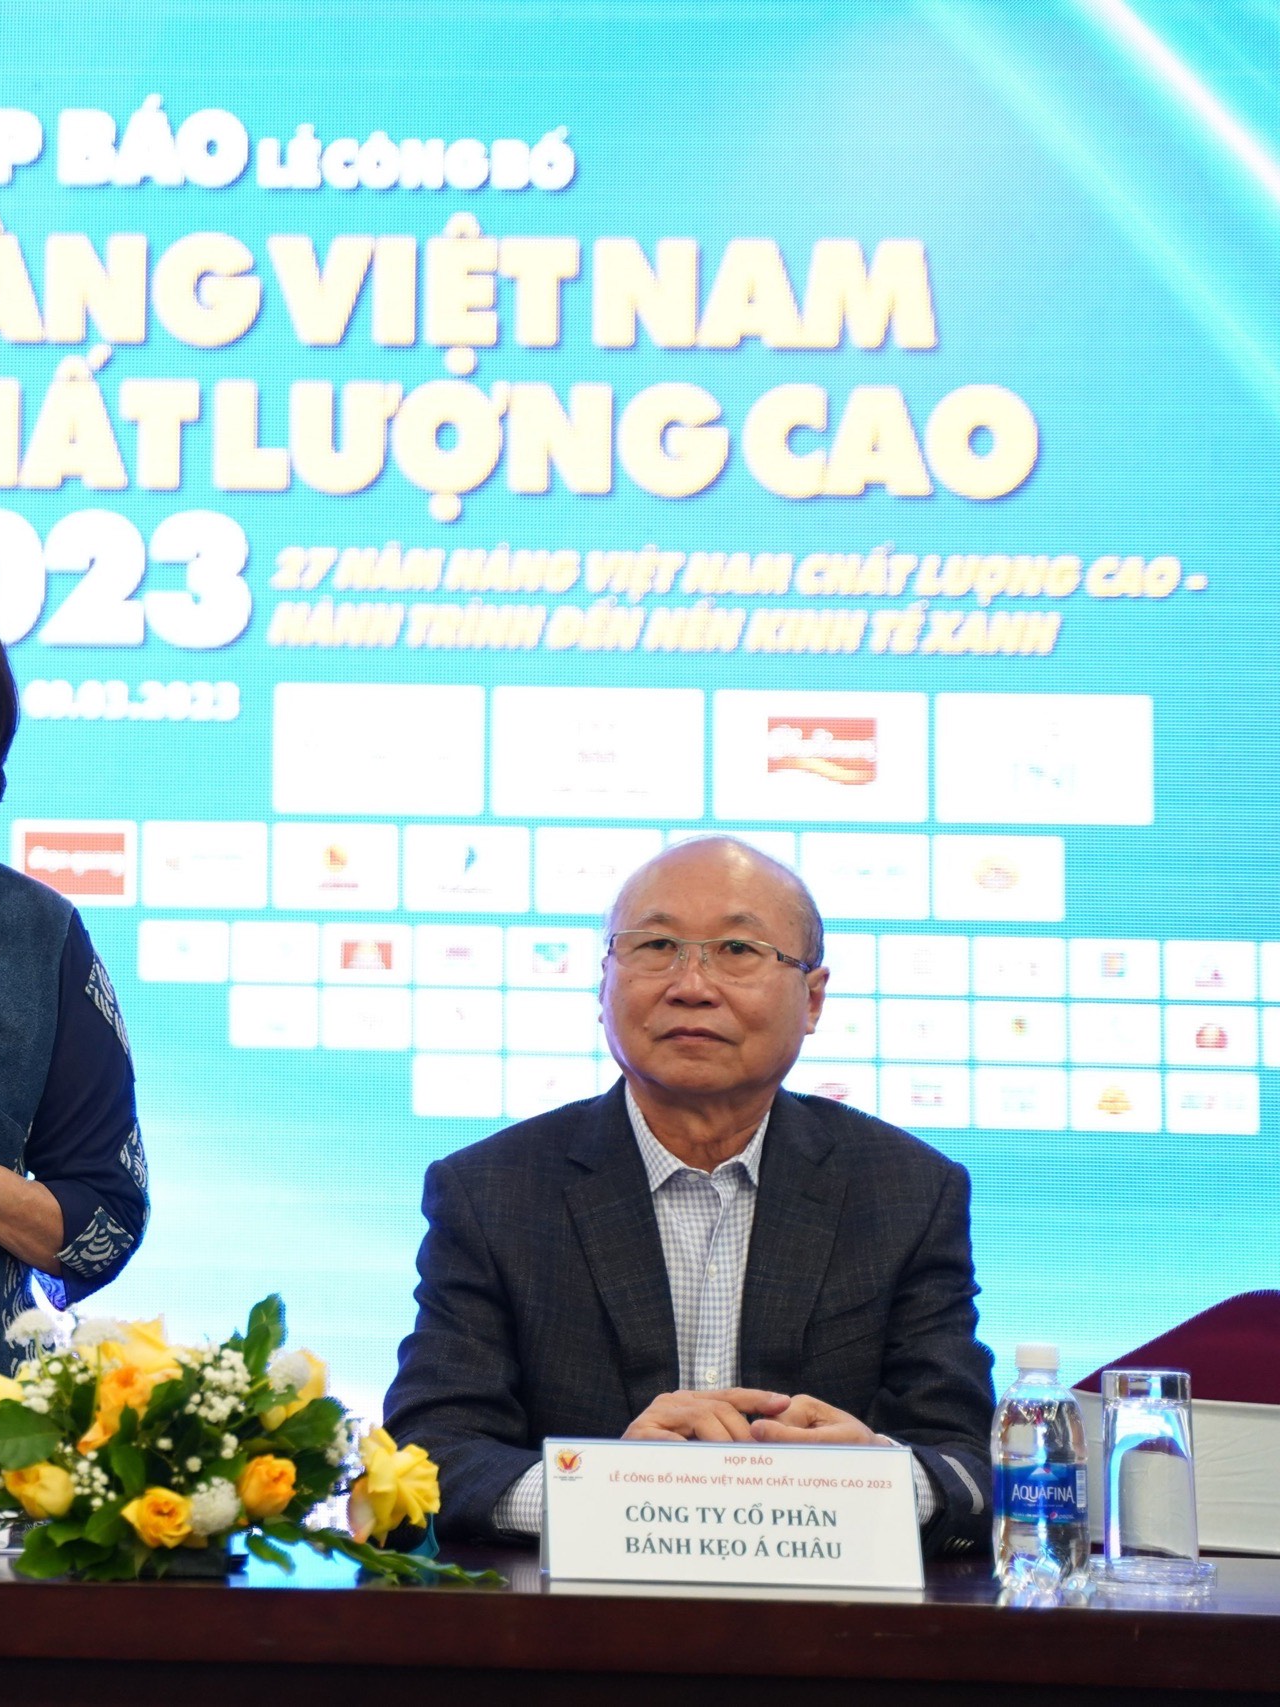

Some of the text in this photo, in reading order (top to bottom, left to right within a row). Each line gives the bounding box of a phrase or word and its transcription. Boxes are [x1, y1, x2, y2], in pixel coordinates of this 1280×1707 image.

[57, 93, 249, 188] BÁO
[267, 211, 579, 376] VIỆT
[592, 237, 938, 350] NAM
[214, 378, 729, 522] LƯỢNG
[743, 383, 1038, 501] CAO
[271, 547, 337, 589] 27
[682, 552, 794, 594] NAM
[1086, 557, 1181, 598] CAO
[923, 611, 1061, 655] XANH
[724, 1454, 774, 1467] HỌP BÁO
[623, 1472, 655, 1483] CÔNG
[676, 1473, 707, 1485] HÀNG
[710, 1475, 735, 1487] VIỆT
[737, 1476, 763, 1486] NAM
[766, 1473, 795, 1487] CHẤT
[798, 1477, 838, 1489] LƯỢNG
[841, 1478, 864, 1488] CAO
[867, 1480, 893, 1489] 2023
[1011, 1483, 1075, 1504] AQUAFINA
[625, 1501, 838, 1528] CÔNG TY CỔ PHẦN
[625, 1533, 842, 1560] BÁNH KẸO Á CHÂU
